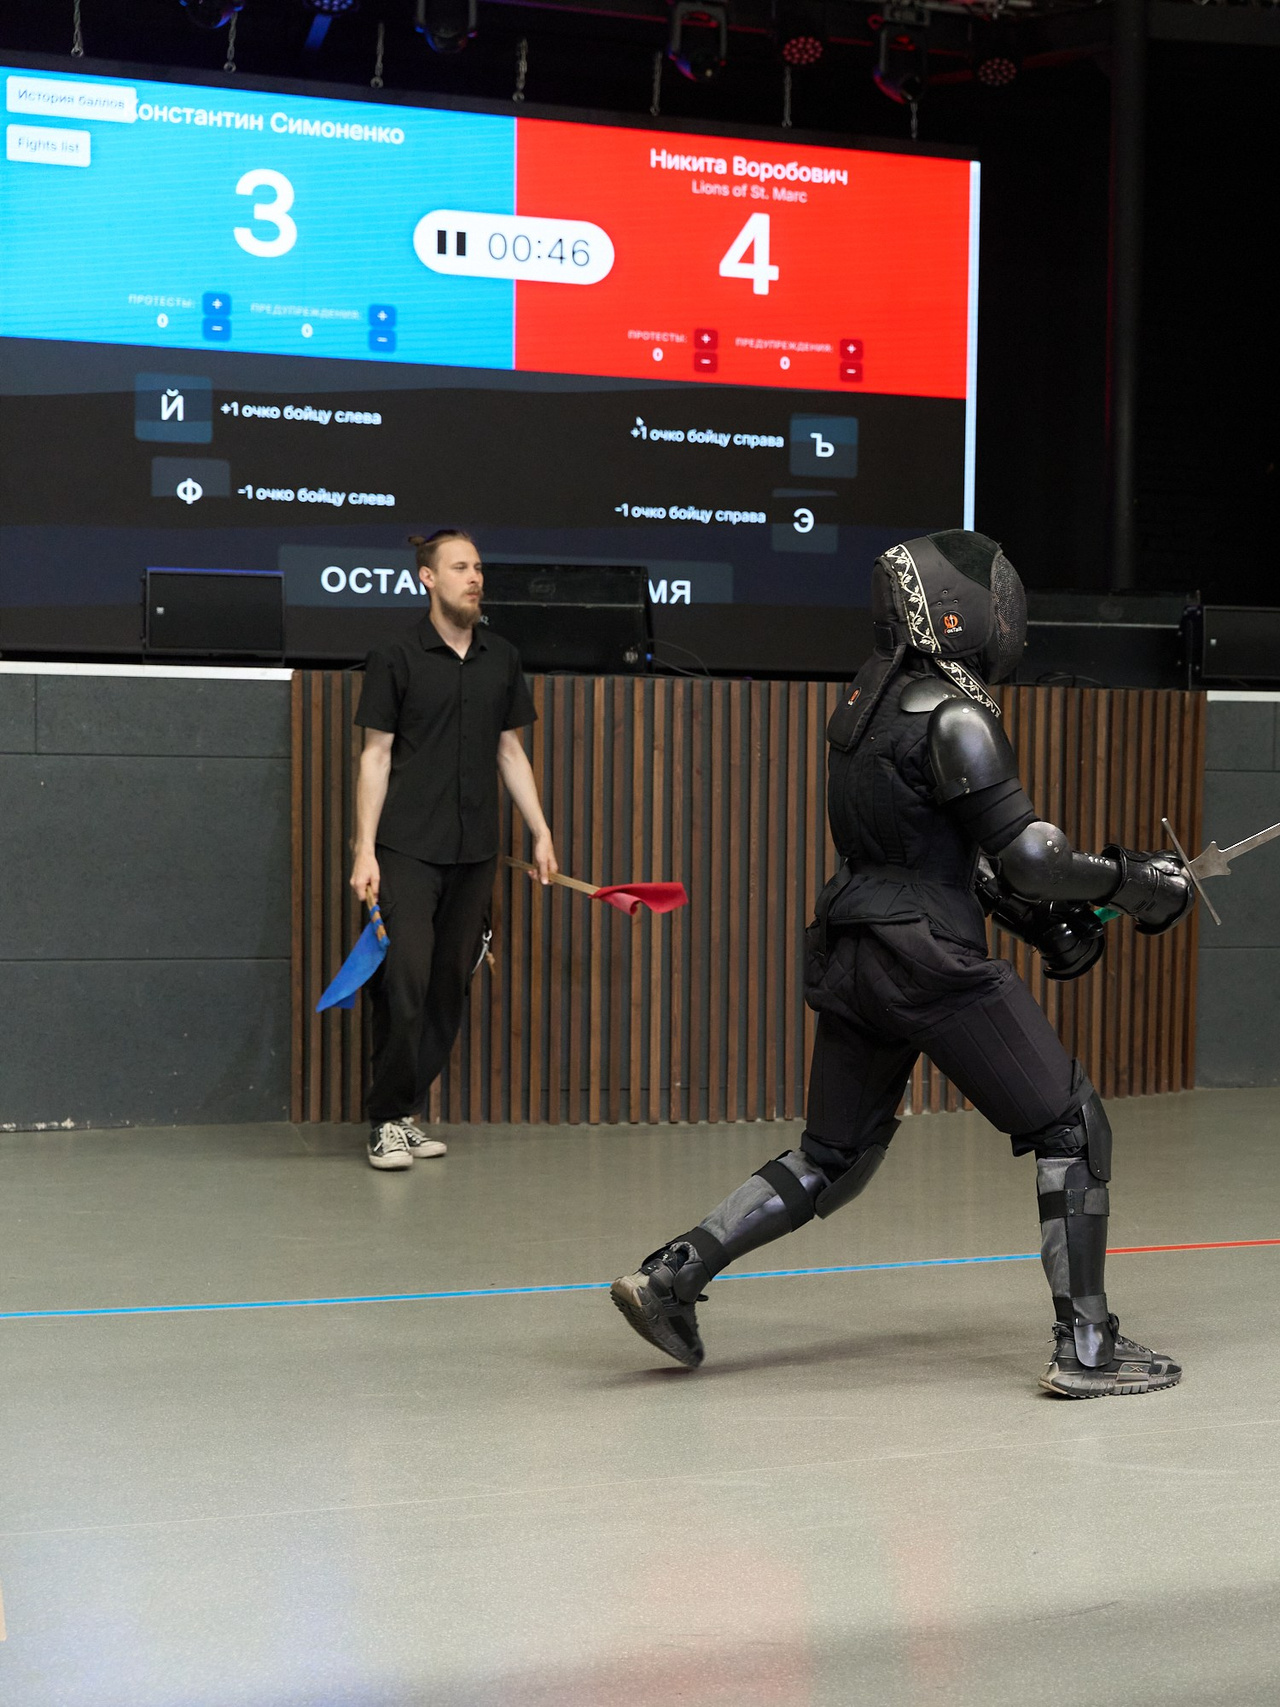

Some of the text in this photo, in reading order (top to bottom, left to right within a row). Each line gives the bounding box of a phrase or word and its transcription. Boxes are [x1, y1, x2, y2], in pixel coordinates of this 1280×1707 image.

[18, 88, 125, 110] История баллов
[270, 112, 405, 145] Симоненко
[18, 136, 79, 153] Fights list
[650, 148, 848, 186] Никита Воробович
[692, 179, 808, 203] Lions of St. Marc
[233, 168, 298, 258] 3
[488, 232, 591, 267] 00:46
[718, 212, 780, 296] 4
[128, 294, 195, 309] ПРОТЕСТЫ:
[156, 313, 169, 328] 0
[301, 323, 313, 338] 0
[627, 330, 687, 343] ПРОТЕСТЫ:
[652, 347, 664, 362] 0
[779, 356, 791, 370] 0
[160, 388, 185, 422] Й
[220, 401, 382, 425] +1 очко бойцу слева
[630, 426, 784, 449] +1 очко бойцу справа
[810, 432, 835, 458] Ъ
[176, 477, 203, 505] Ф
[237, 484, 396, 507] -1 очко бойцу слева
[614, 503, 767, 525] -1 очко бойцу справа
[793, 507, 815, 533] Э
[320, 565, 692, 605] ОСТА МЯ
